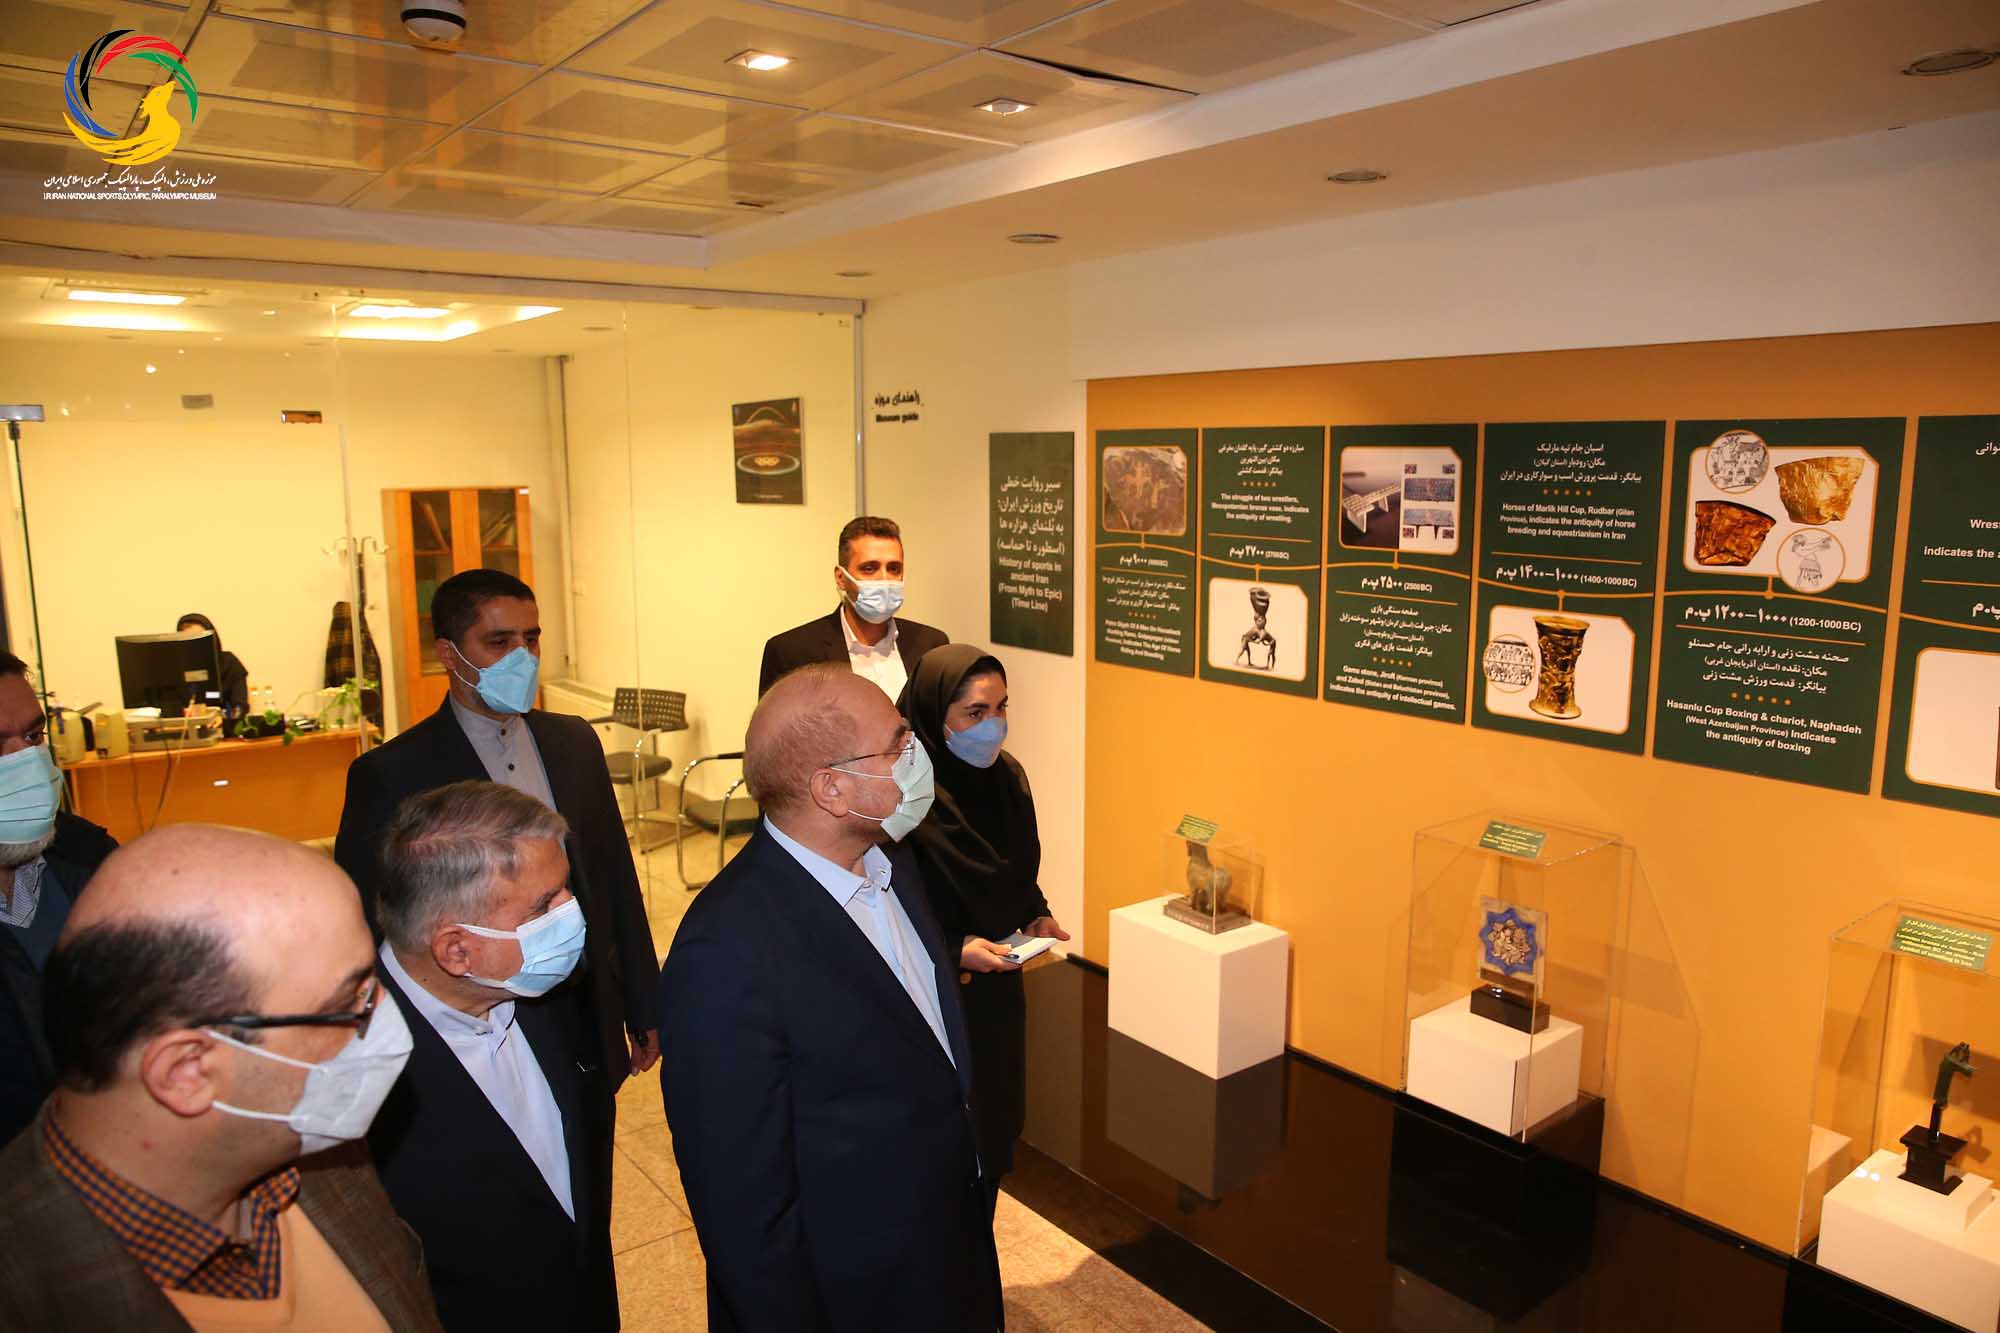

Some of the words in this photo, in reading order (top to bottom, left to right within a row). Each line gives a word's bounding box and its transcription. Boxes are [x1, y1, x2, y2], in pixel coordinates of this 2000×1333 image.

[1976, 442, 2000, 456] وانی
[1000, 475, 1019, 492] خطی
[1021, 475, 1044, 492] روایت
[1044, 481, 1062, 492] سیر
[1019, 497, 1041, 513] ورزش
[1043, 498, 1064, 514] تاریخ
[1502, 504, 1526, 512] Horses
[1527, 504, 1535, 512] of
[1557, 505, 1569, 513] Hill
[1570, 506, 1587, 515] Cup,
[1588, 506, 1615, 515] Rudbar
[1560, 517, 1572, 525] the
[1573, 518, 1604, 528] antiquity
[1614, 520, 1636, 528] horse
[1970, 519, 2000, 530] Wres
[1056, 523, 1064, 536] به
[1507, 526, 1536, 537] breeding
[1538, 527, 1551, 536] and
[1611, 531, 1626, 540] Iran
[1924, 546, 1973, 558] indicates
[1976, 548, 1995, 558] the
[999, 556, 1022, 569] History
[1023, 560, 1031, 568] of
[1032, 561, 1053, 571] sports
[1054, 562, 1061, 571] in
[1380, 576, 1402, 588] ۲۵۰۰
[1019, 585, 1035, 597] Myth
[1036, 588, 1043, 597] to
[1688, 638, 1715, 649] حسنلو
[1717, 641, 1733, 652] جام
[1733, 644, 1751, 655] رانی
[1778, 648, 1794, 658] زنی
[1795, 650, 1820, 661] مشت
[1821, 652, 1849, 663] صحنه
[1702, 669, 1718, 680] زنی
[1782, 664, 1801, 674] نقده
[1719, 672, 1742, 681] مشت
[1743, 674, 1768, 687] ورزش
[1769, 678, 1795, 688] قدمت
[1666, 699, 1703, 712] Hasanlu
[1704, 704, 1724, 716] Cup
[1725, 707, 1758, 722] Boxing
[1760, 712, 1768, 721] &
[1770, 714, 1807, 729] chariot,
[1810, 718, 1862, 735] Naghadeh
[1685, 714, 1707, 726] (West
[1751, 725, 1789, 738] Province)
[1706, 729, 1720, 739] the
[1722, 733, 1763, 748] antiquity
[1765, 739, 1776, 748] of
[1777, 740, 1811, 755] boxing
